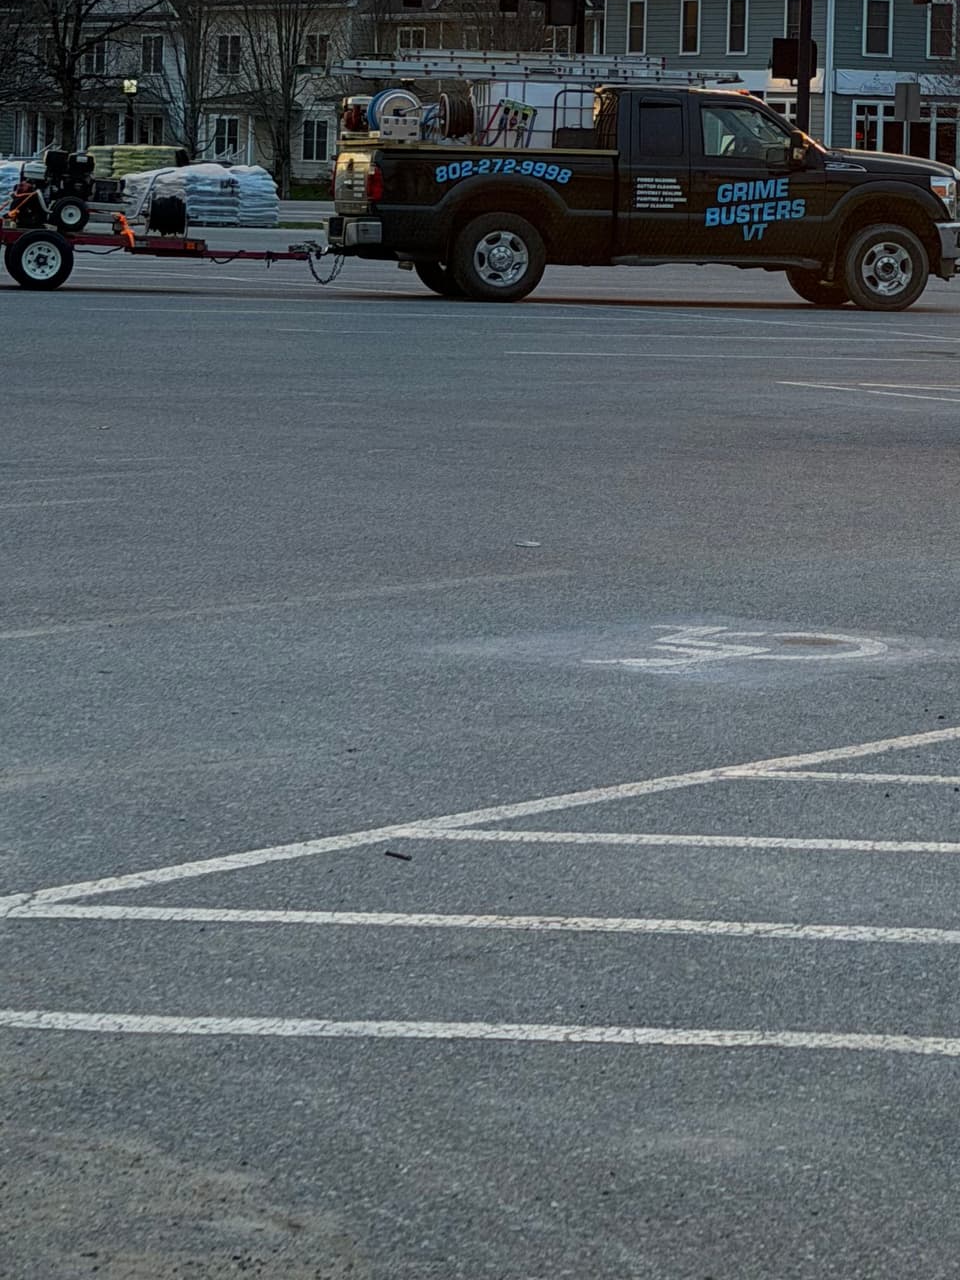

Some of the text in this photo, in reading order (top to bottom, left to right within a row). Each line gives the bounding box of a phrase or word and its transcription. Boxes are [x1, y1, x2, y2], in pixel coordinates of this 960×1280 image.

[435, 159, 572, 184] 802-272-9998
[717, 177, 789, 203] GRIME
[705, 198, 805, 227] BUSTERS
[743, 223, 768, 241] VT
